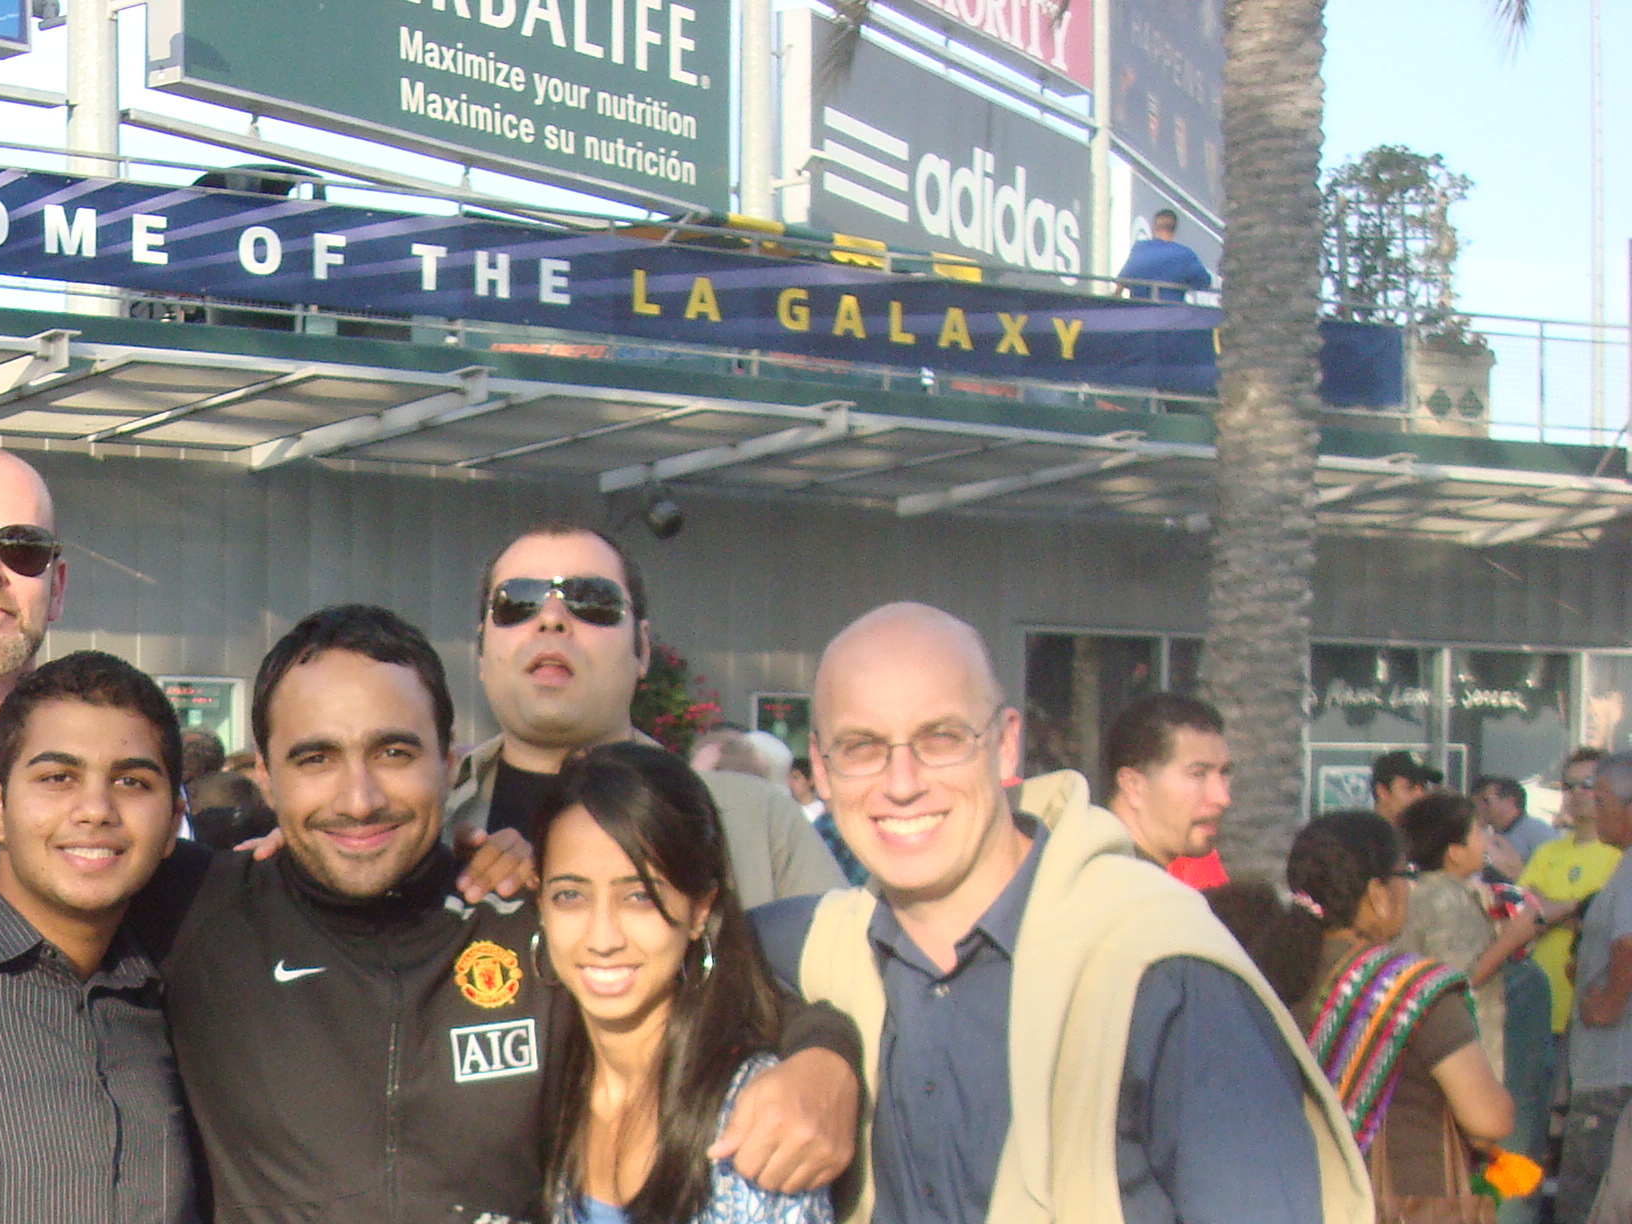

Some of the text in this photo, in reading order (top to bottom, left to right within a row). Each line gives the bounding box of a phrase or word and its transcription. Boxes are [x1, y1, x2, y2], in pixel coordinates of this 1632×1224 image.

[399, 26, 698, 140] Maximize your nutrition
[399, 77, 698, 187] Maximice su nutrición
[915, 147, 1082, 288] adidas
[239, 226, 348, 281] OF
[411, 243, 572, 305] THE
[633, 268, 722, 323] LA
[778, 287, 1083, 361] GALAXY
[461, 1028, 531, 1076] AIG
